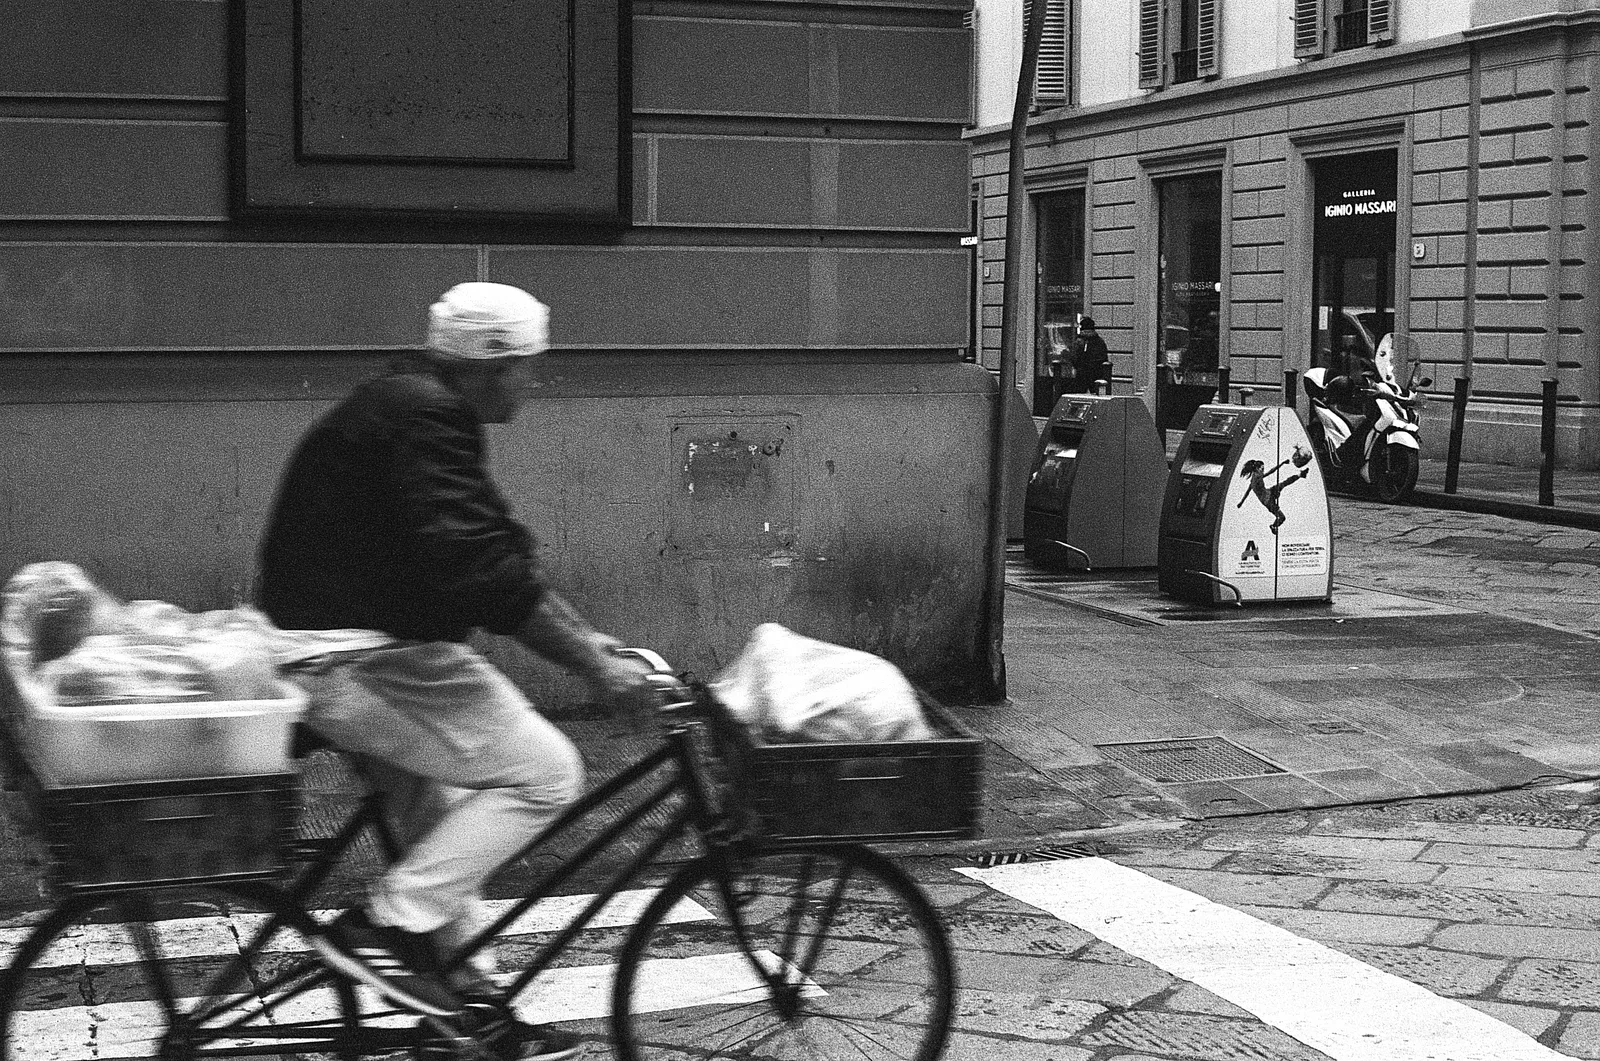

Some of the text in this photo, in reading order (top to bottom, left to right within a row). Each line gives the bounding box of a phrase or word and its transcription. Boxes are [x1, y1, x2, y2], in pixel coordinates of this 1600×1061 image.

[1342, 189, 1376, 198] GALLERIA
[1324, 200, 1397, 217] IGINIO MASSARI
